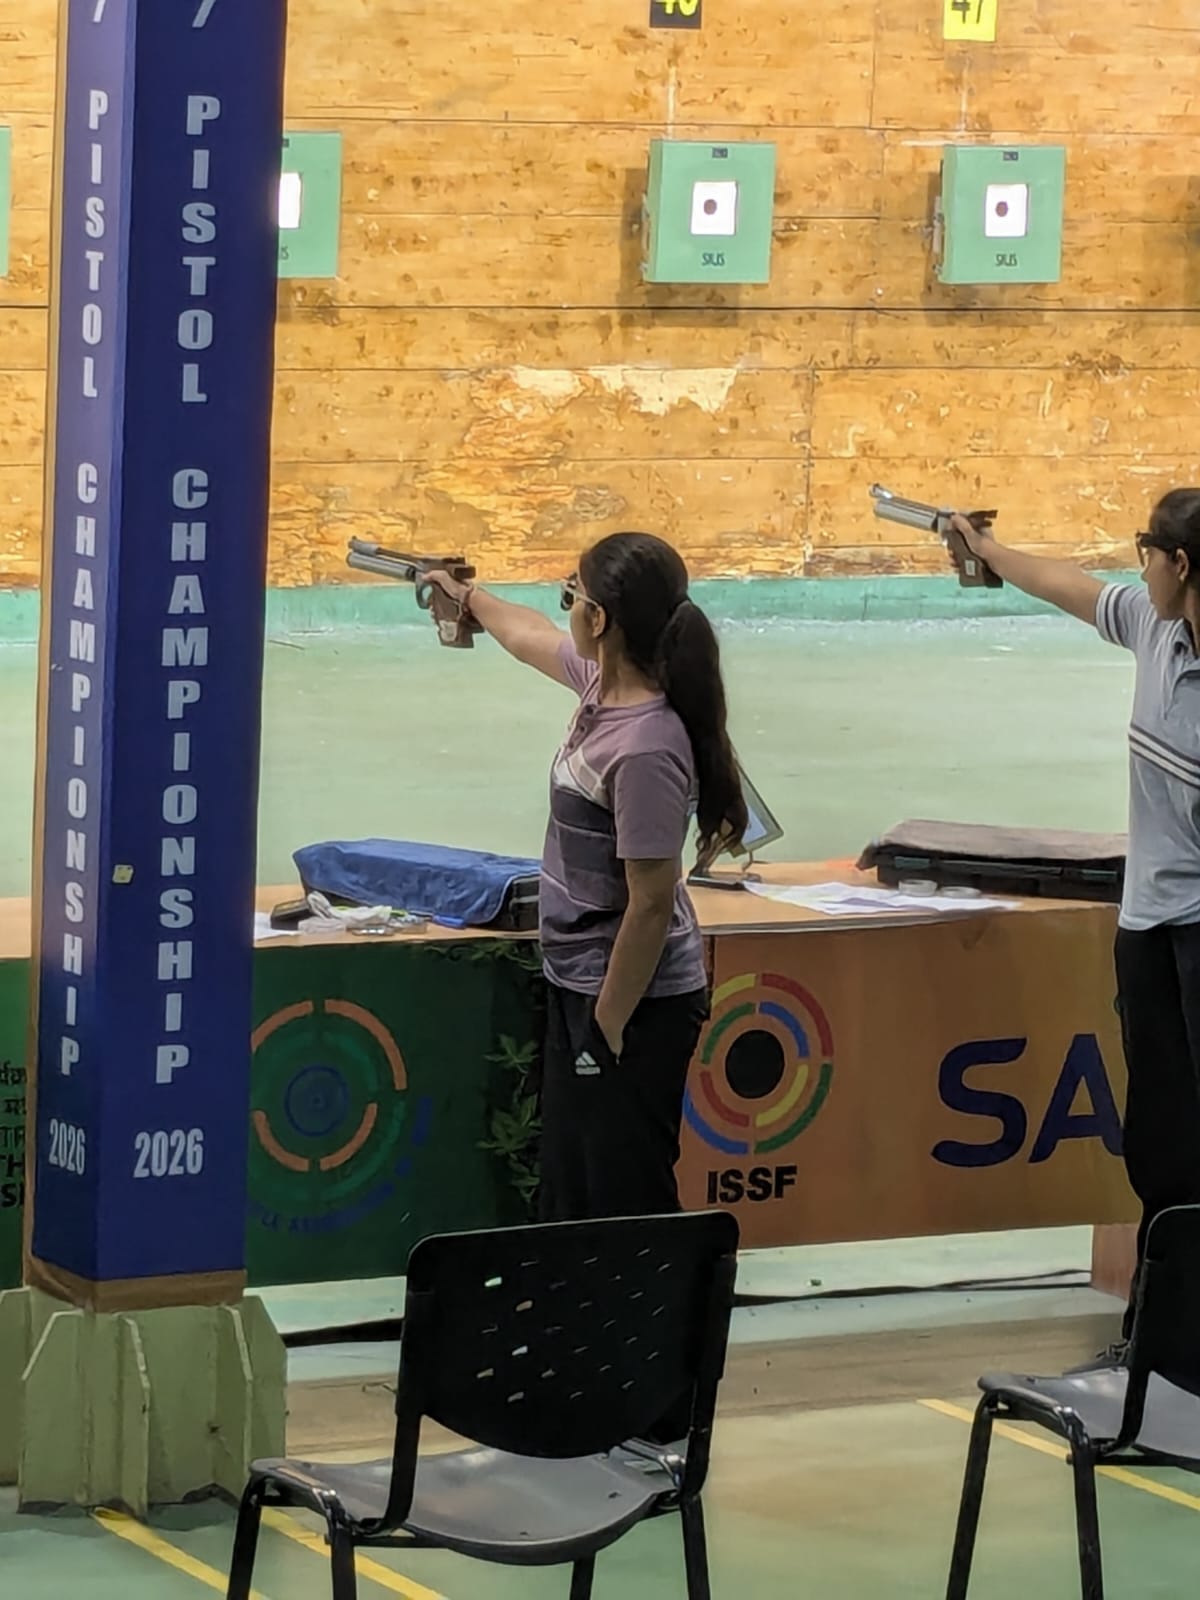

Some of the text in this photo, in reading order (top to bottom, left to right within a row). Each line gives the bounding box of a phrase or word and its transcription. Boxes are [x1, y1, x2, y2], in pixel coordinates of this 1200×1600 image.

[82, 90, 108, 397] PISTOL
[178, 94, 220, 402] PISTOL
[61, 462, 98, 1076] CHAMPIONSHIP
[155, 468, 209, 1085] CHAMPIONSHIP
[48, 1117, 87, 1177] 2026
[132, 1127, 205, 1179] 2026
[706, 1165, 798, 1205] ISSF
